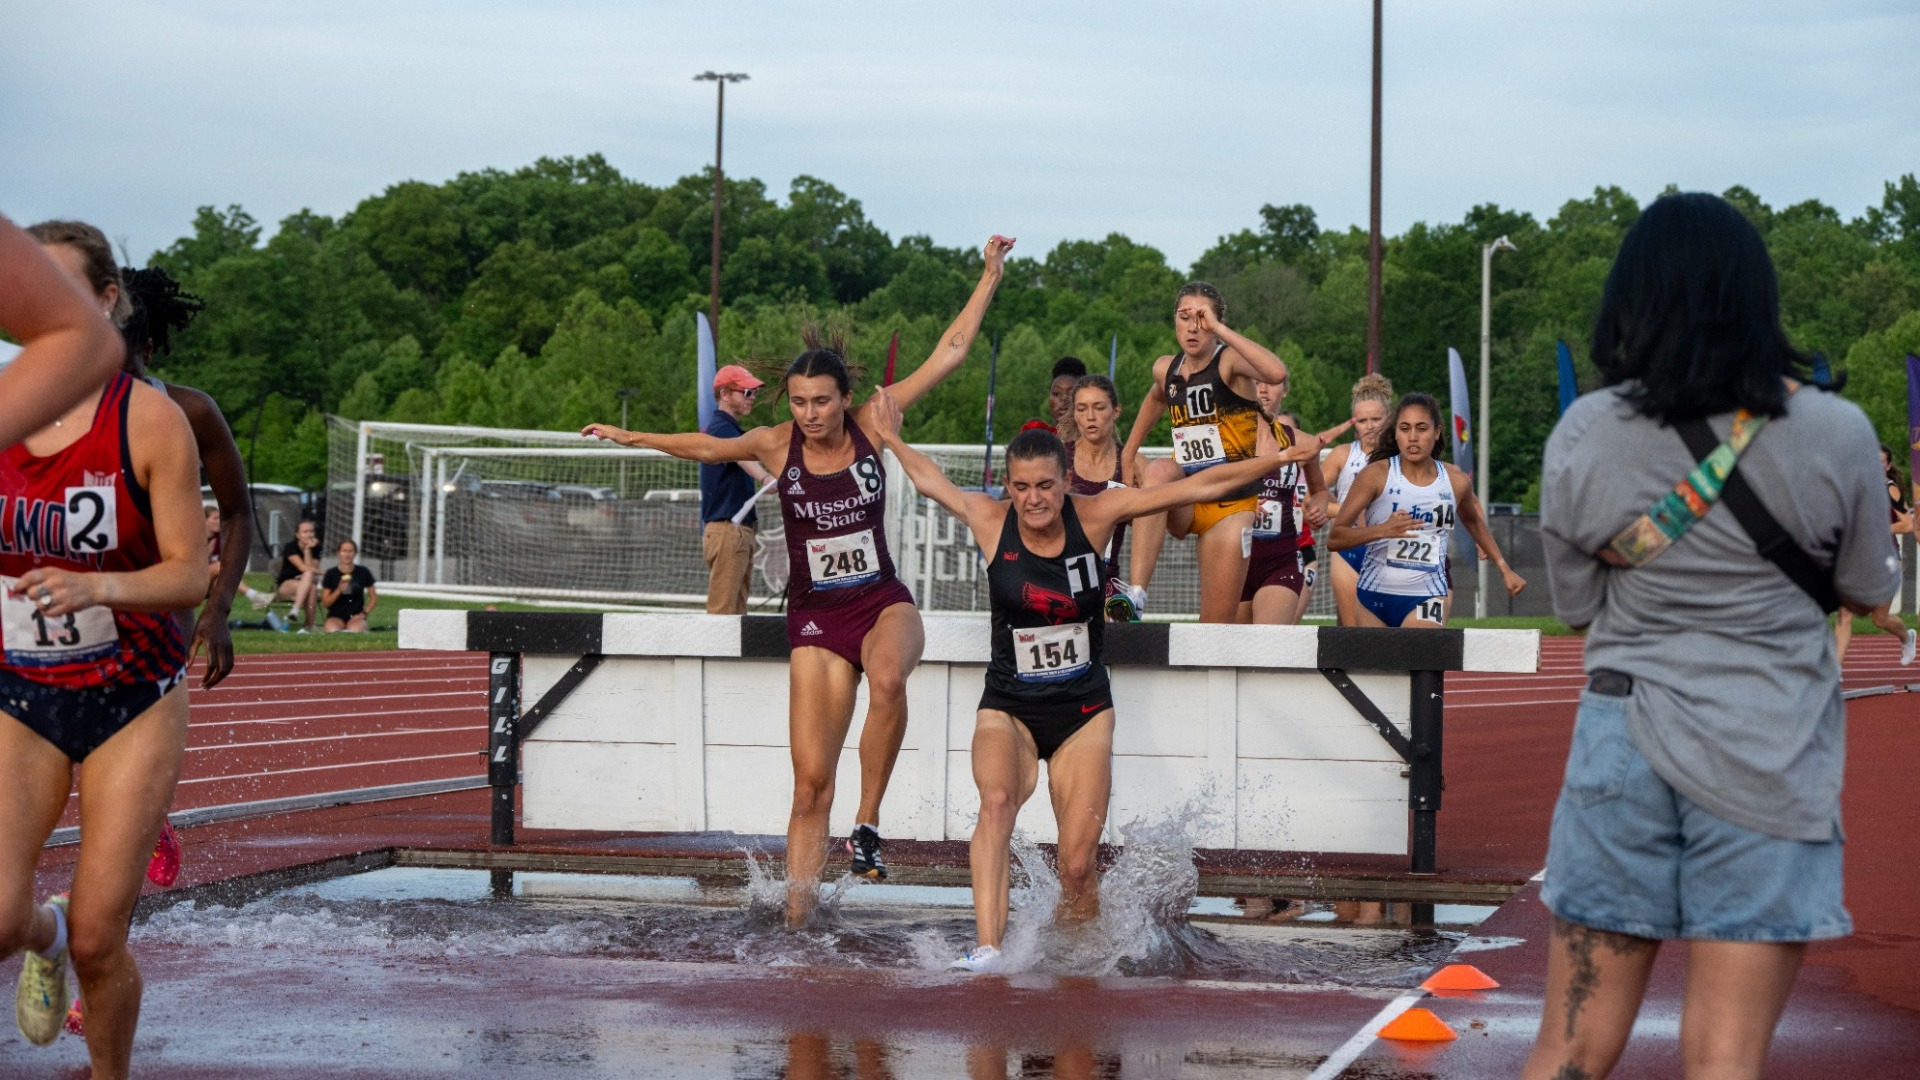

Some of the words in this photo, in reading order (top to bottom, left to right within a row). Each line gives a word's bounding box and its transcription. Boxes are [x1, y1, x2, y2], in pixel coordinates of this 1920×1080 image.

[1187, 387, 1215, 416] 10
[1181, 438, 1215, 462] 386
[856, 457, 880, 493] 8
[68, 490, 109, 550] 2
[815, 510, 867, 531] State
[1433, 504, 1455, 528] 14
[820, 548, 868, 577] 248
[1396, 539, 1433, 563] 222
[1068, 556, 1100, 599] 1
[1305, 568, 1315, 587] 5
[1418, 601, 1442, 623] 14
[31, 608, 81, 647] 13
[1029, 639, 1079, 670] 154
[490, 657, 512, 762] GILL
